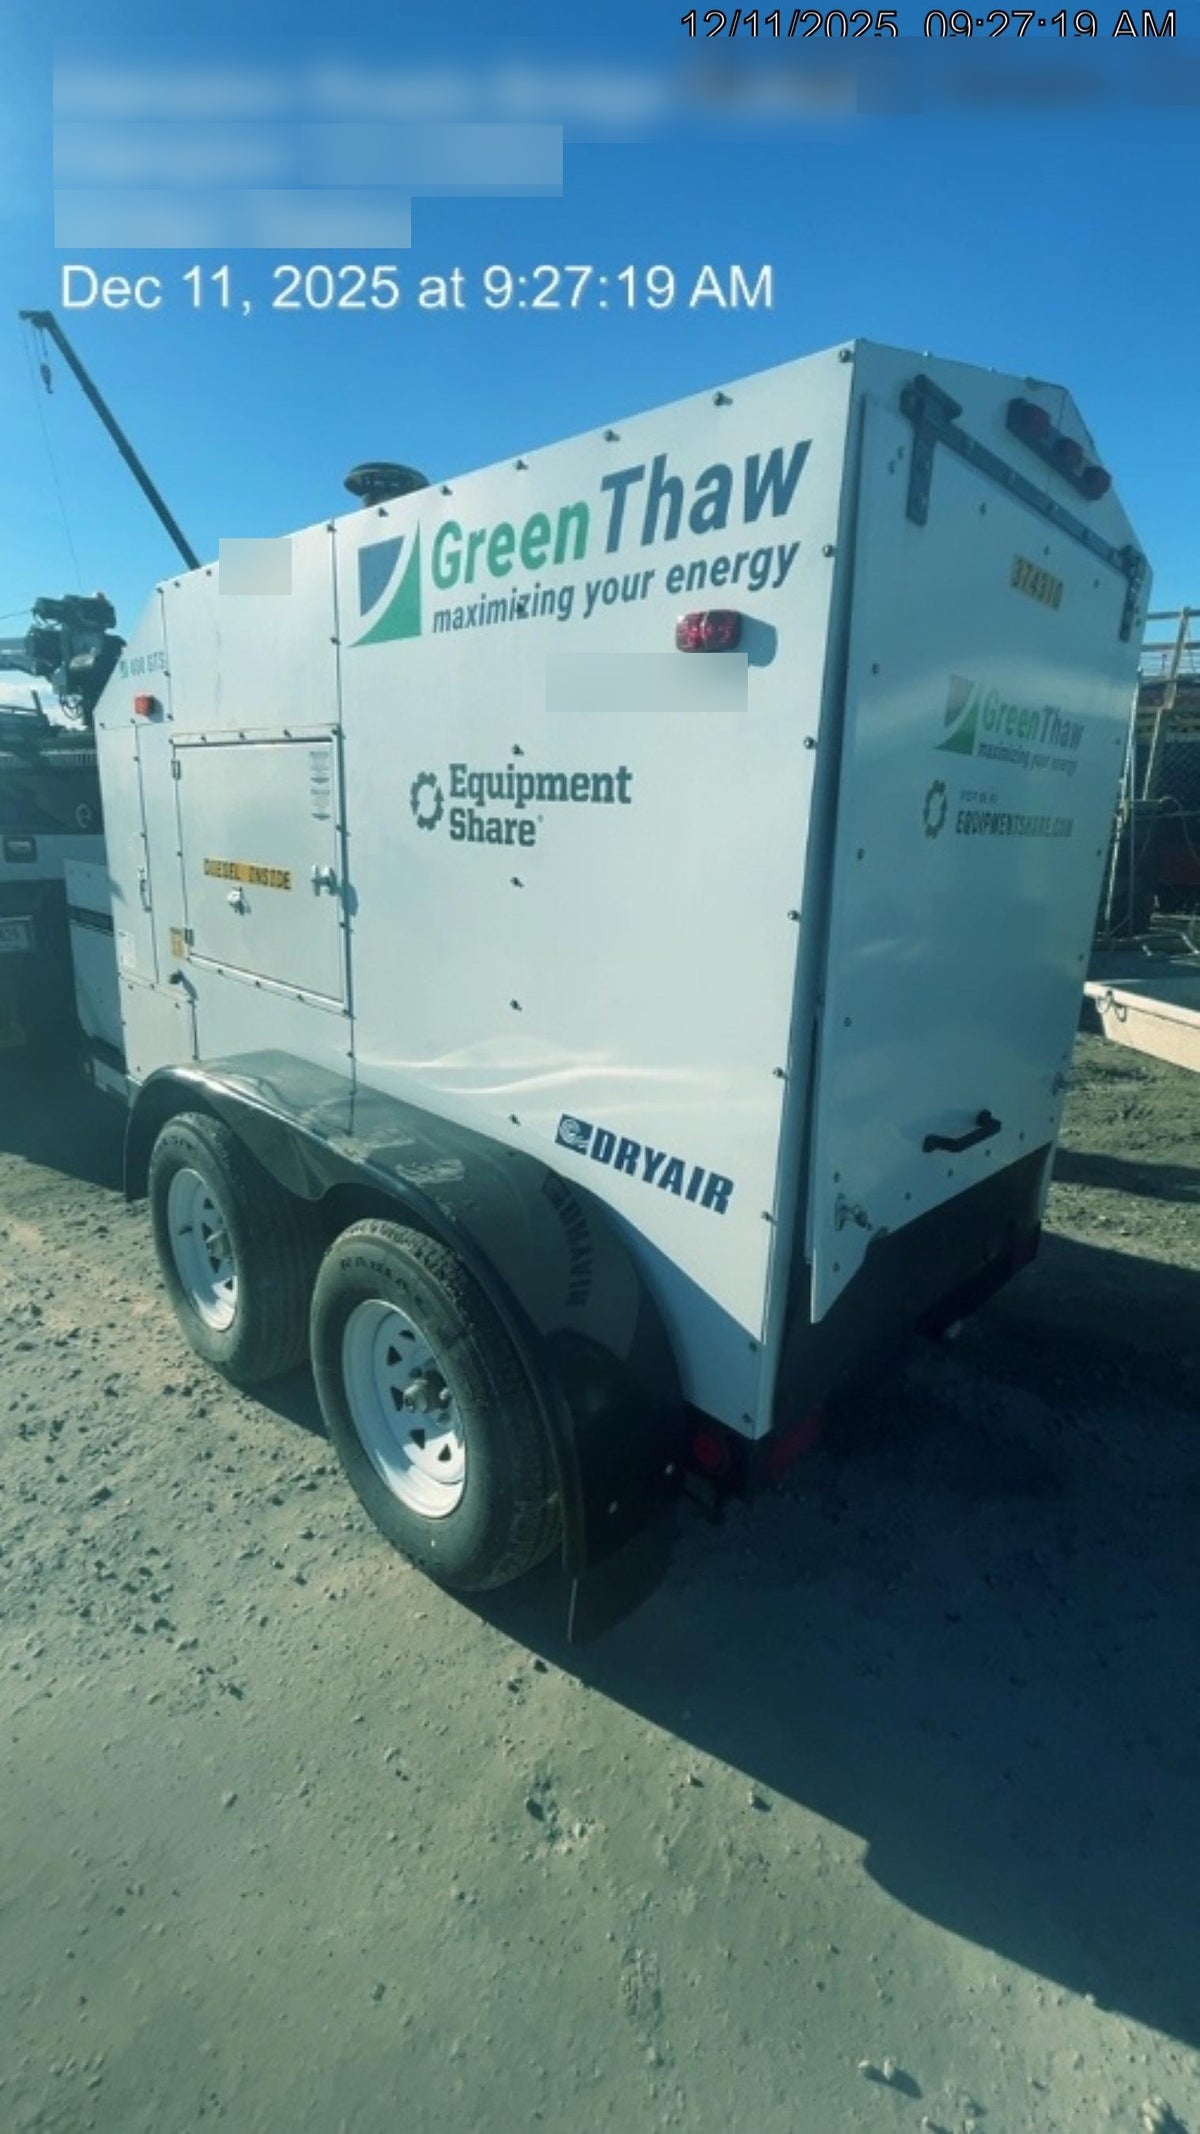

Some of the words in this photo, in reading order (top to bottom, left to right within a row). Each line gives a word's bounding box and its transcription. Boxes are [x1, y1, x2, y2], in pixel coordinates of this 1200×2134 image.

[432, 581, 576, 635] maximizing
[583, 568, 656, 619] your
[665, 540, 802, 594] energy
[448, 762, 633, 809] Equipment
[449, 807, 537, 848] Share
[590, 1126, 735, 1215] DRYAIR
